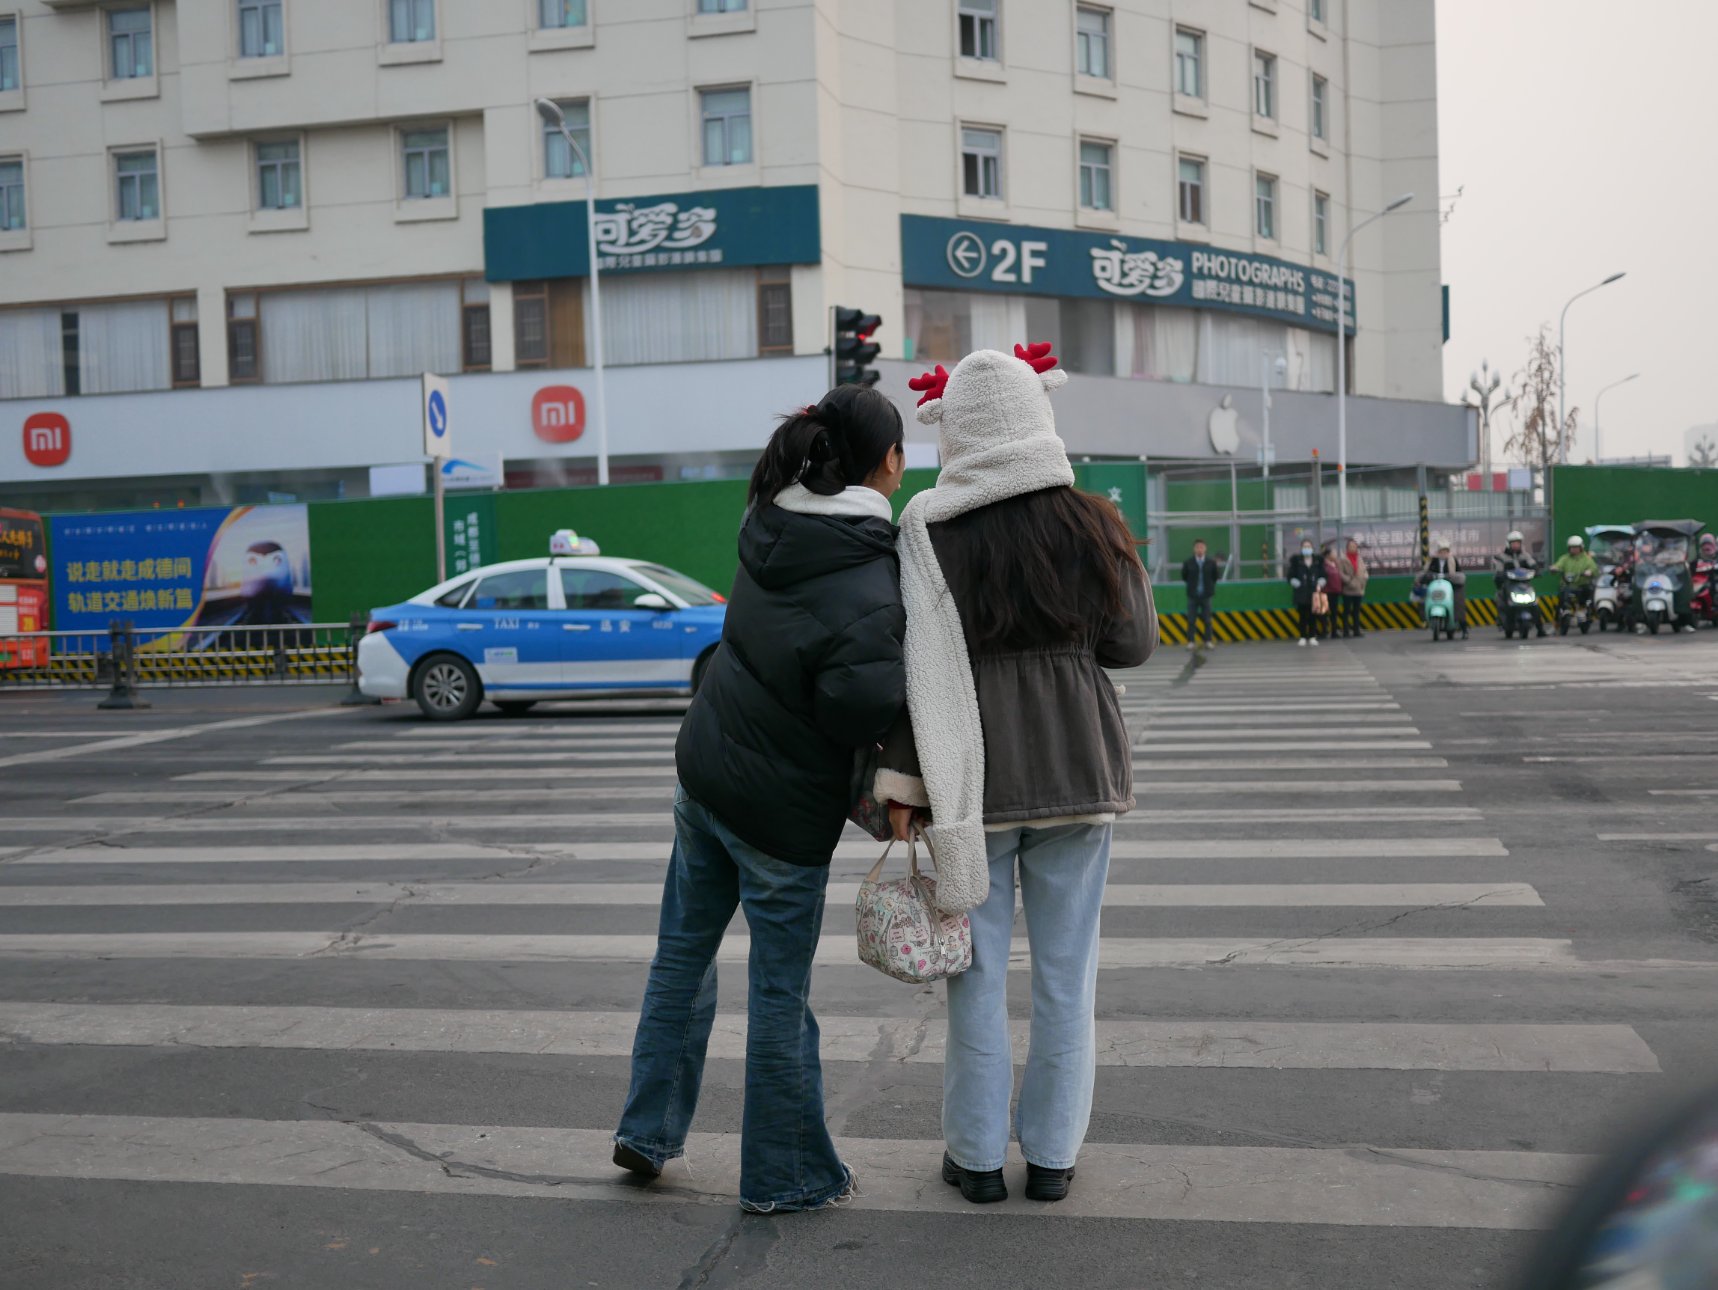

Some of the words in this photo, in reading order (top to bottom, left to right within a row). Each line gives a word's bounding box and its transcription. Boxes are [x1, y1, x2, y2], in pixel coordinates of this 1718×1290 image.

[594, 202, 717, 254] 可爱多
[991, 239, 1047, 284] 2F
[1090, 239, 1184, 297] 可爱多
[1191, 251, 1306, 293] PHOTOGRAPHS
[494, 617, 520, 630] TAXI
